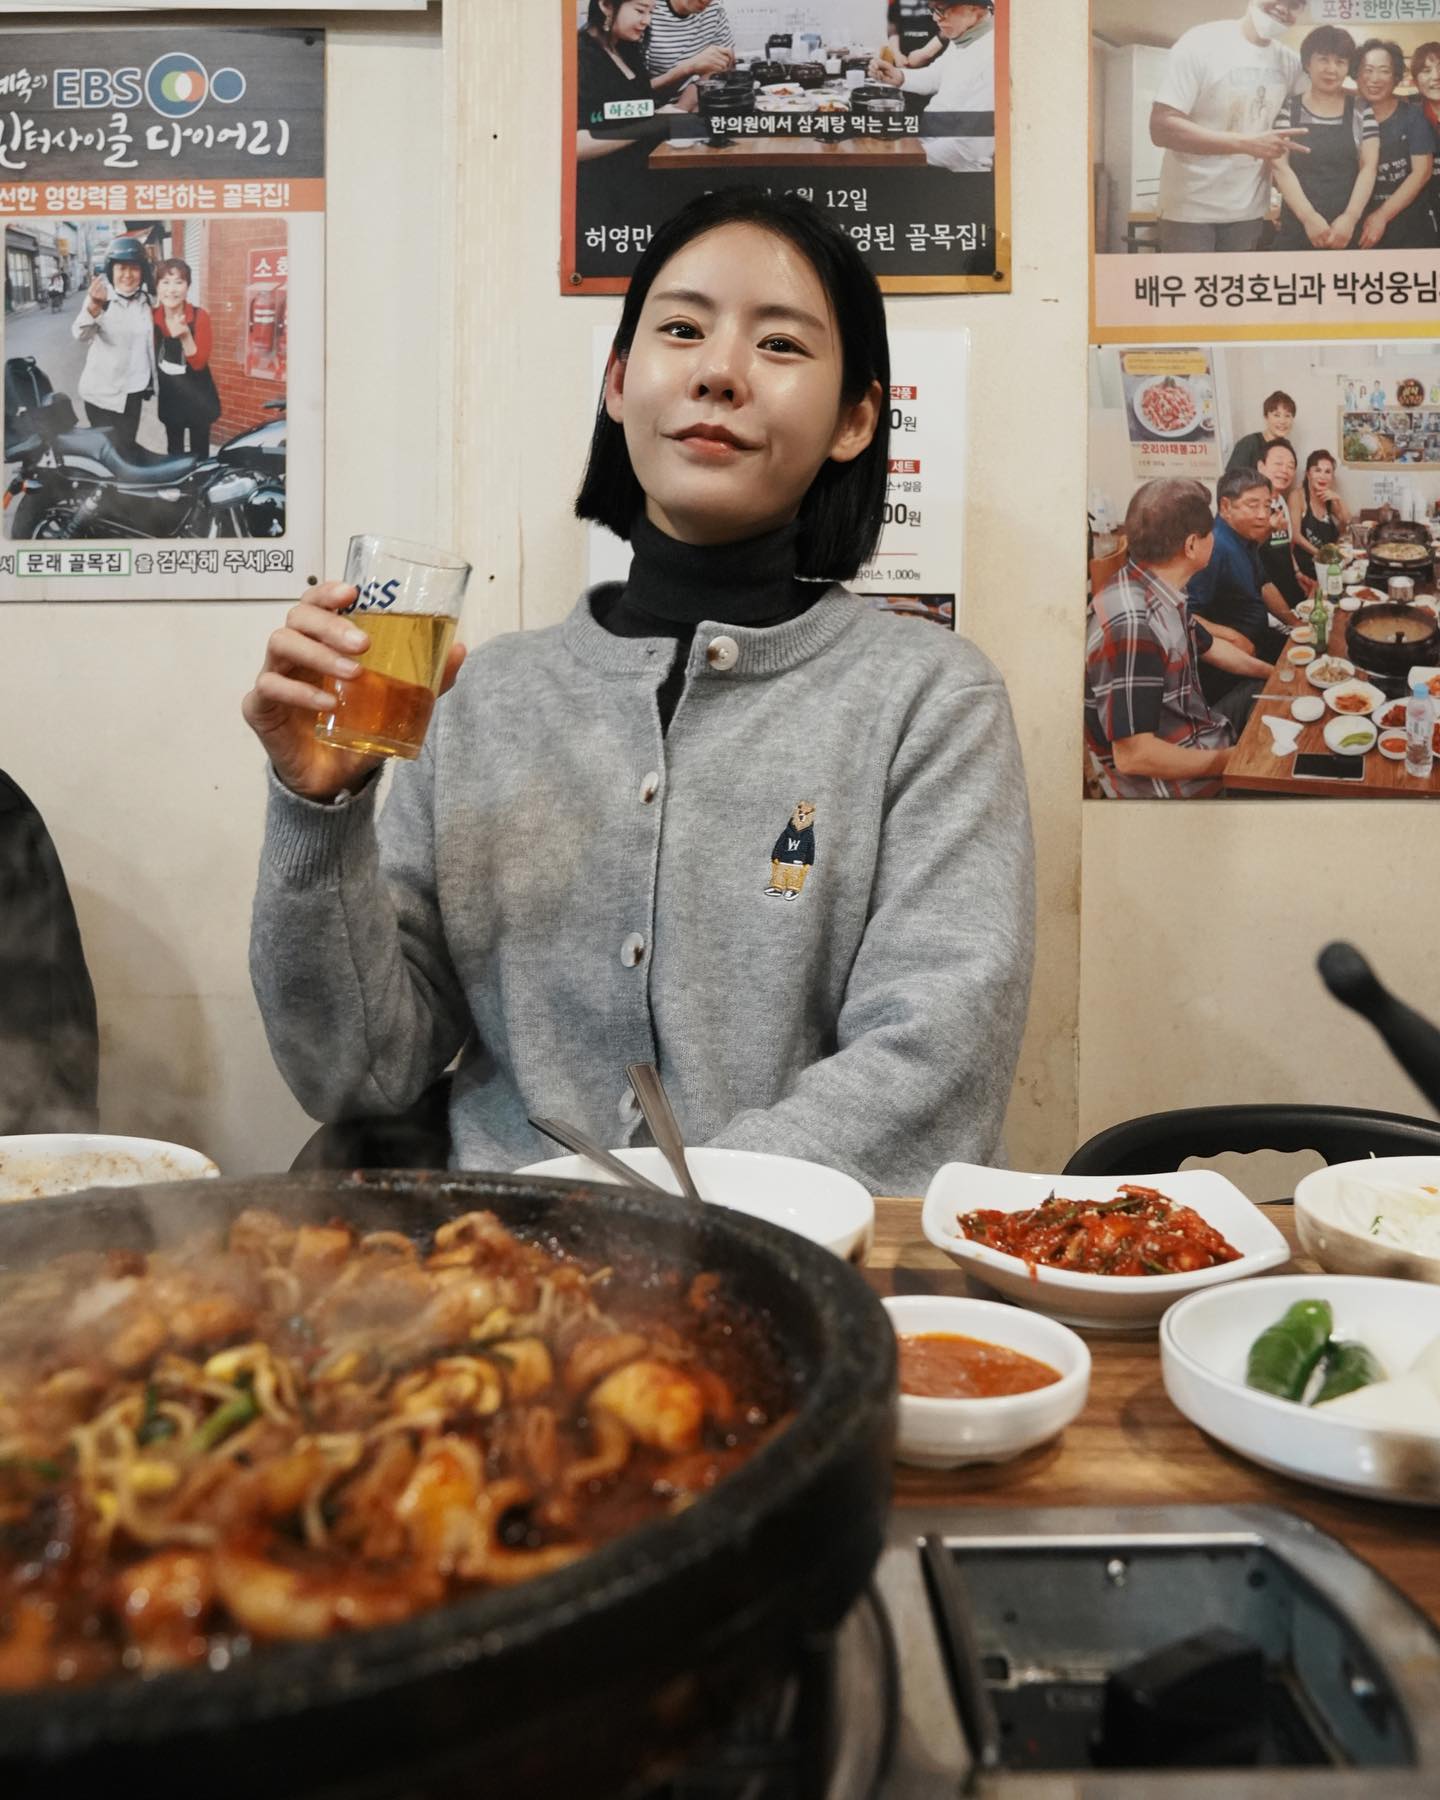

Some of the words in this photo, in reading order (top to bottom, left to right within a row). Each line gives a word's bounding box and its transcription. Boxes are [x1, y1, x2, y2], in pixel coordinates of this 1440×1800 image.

[53, 67, 142, 109] EBS
[145, 119, 290, 157] 다이어리
[711, 116, 792, 134] 한의원에서
[797, 116, 846, 133] 삼계탕
[851, 116, 883, 133] 먹는
[887, 115, 919, 133] 느낌
[0, 186, 39, 211] 선한
[45, 185, 128, 211] 영향력을
[134, 184, 217, 209] 전달하는
[223, 183, 290, 208] 골목집!
[784, 188, 814, 202] 월
[826, 188, 868, 211] 12일
[584, 224, 654, 253] 허영만
[839, 223, 895, 252] 영된
[905, 222, 987, 251] 골목집!
[1134, 275, 1187, 307] 배우
[1194, 272, 1326, 307] 정경호님과
[1333, 270, 1440, 304] 박성웅님
[27, 553, 61, 573] 문래
[69, 553, 122, 573] 골목집
[157, 550, 219, 574] 검색해
[224, 550, 294, 574] 주세요!
